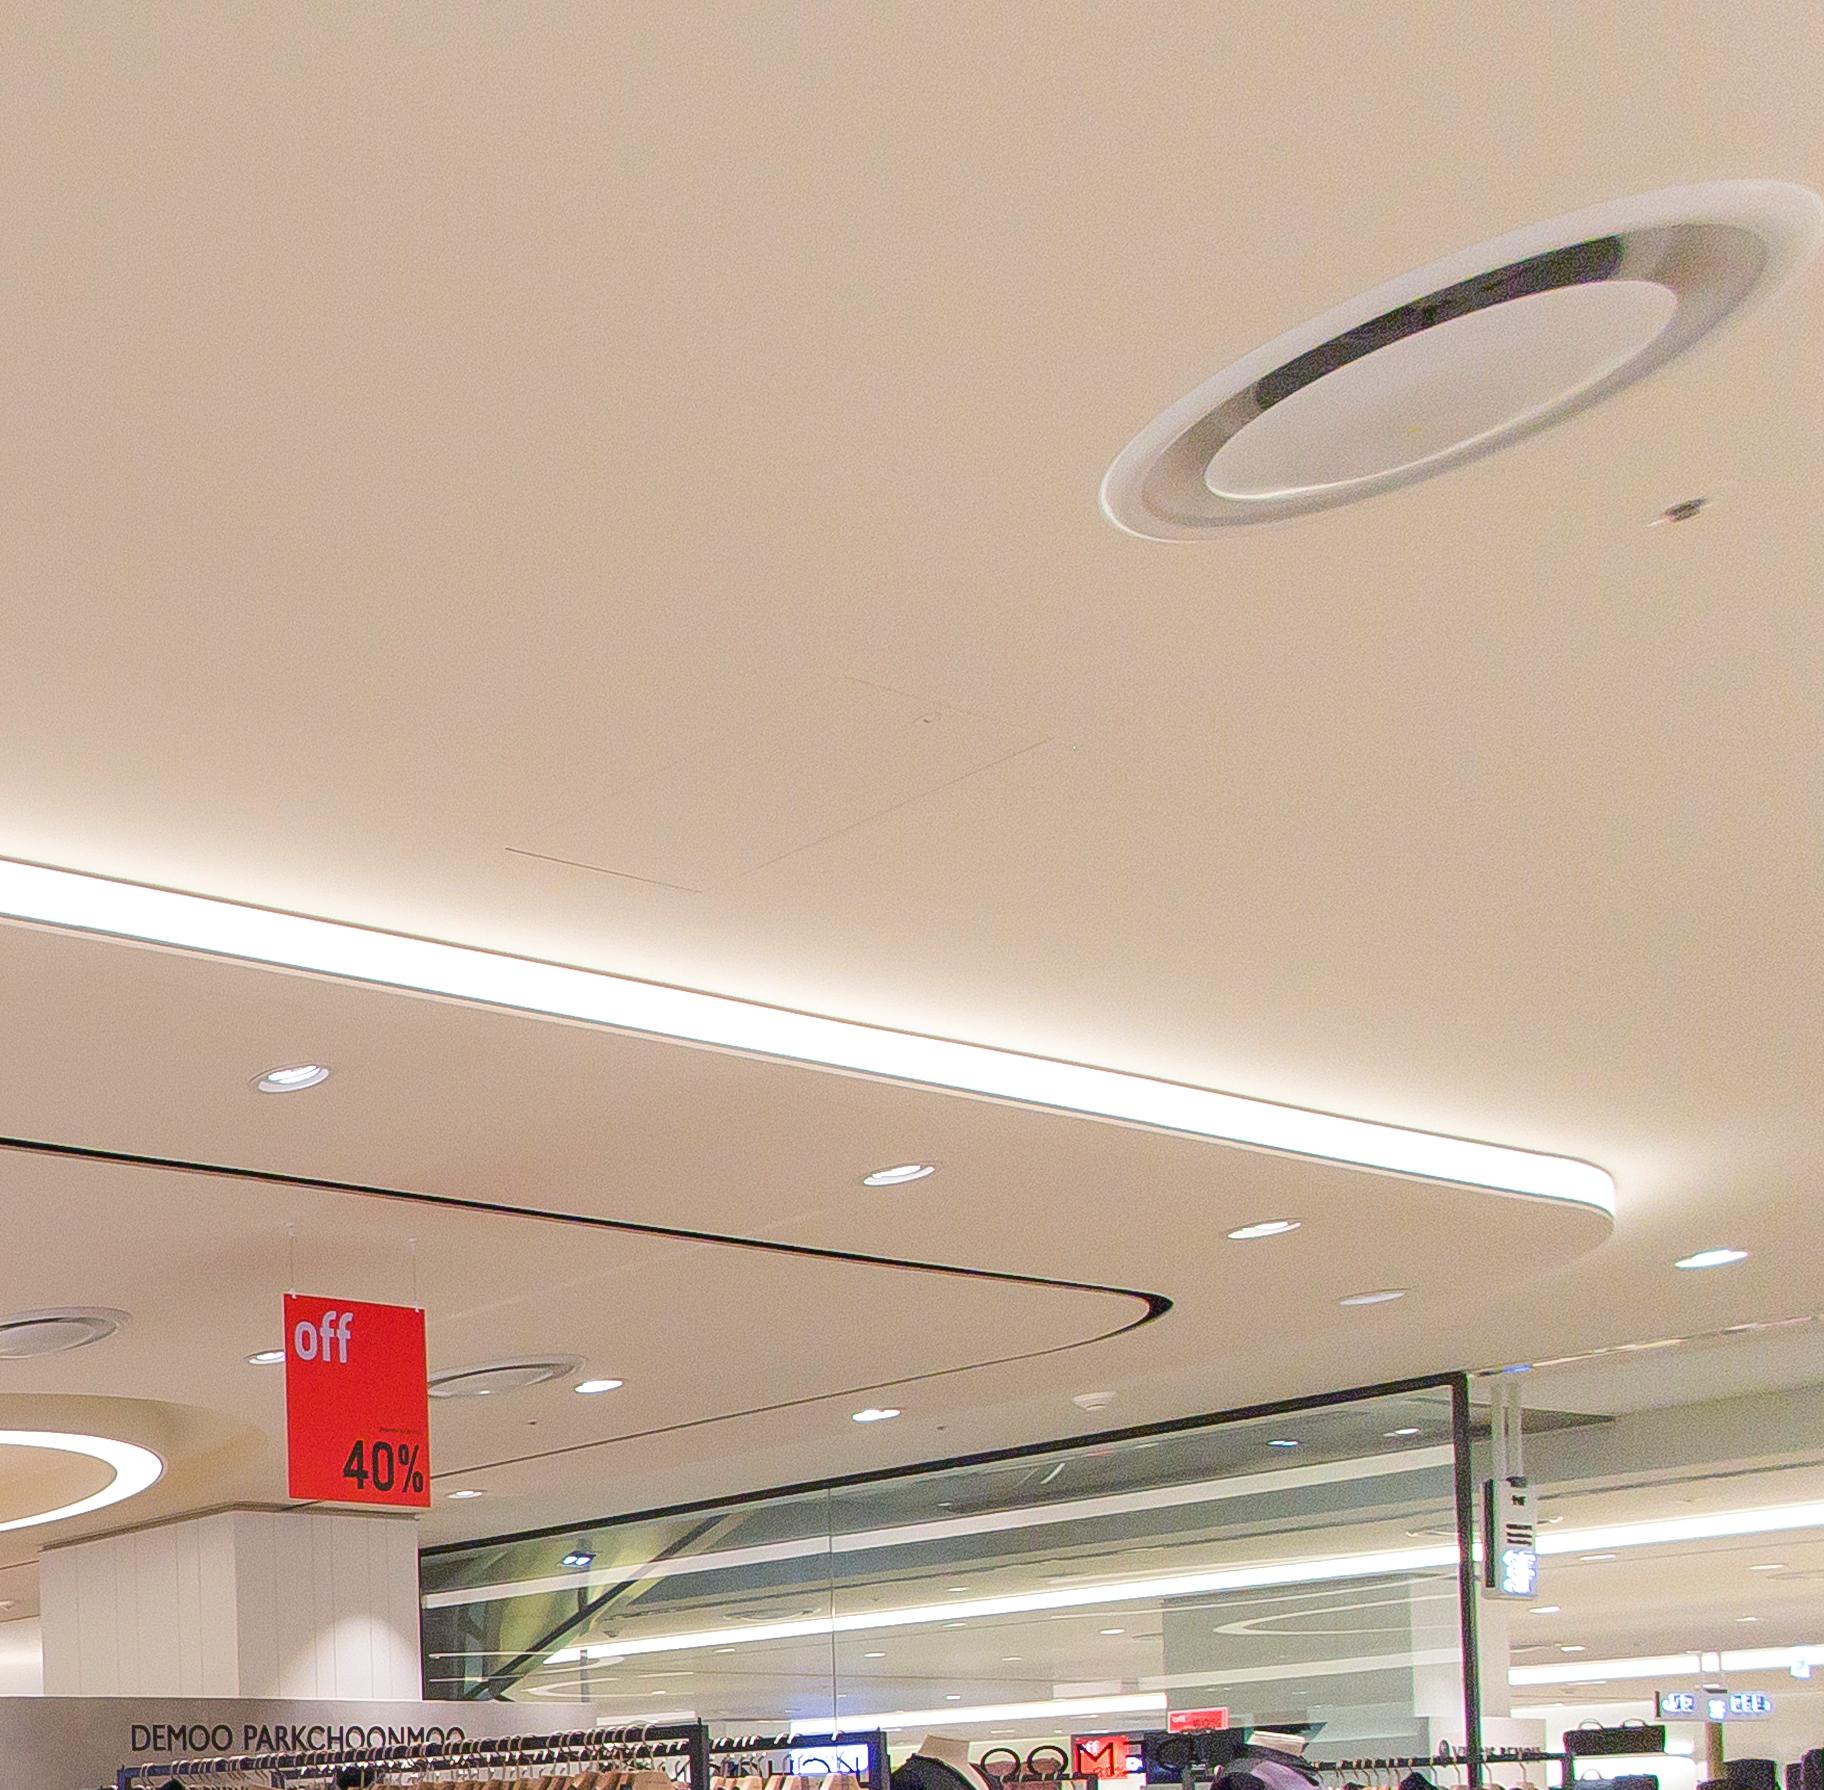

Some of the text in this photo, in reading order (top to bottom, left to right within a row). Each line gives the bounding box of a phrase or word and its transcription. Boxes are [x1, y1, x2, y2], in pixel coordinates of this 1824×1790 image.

[294, 1311, 353, 1364] off
[343, 1440, 424, 1493] 40%
[131, 1724, 465, 1752] DEMOO PARKCHOONMOO
